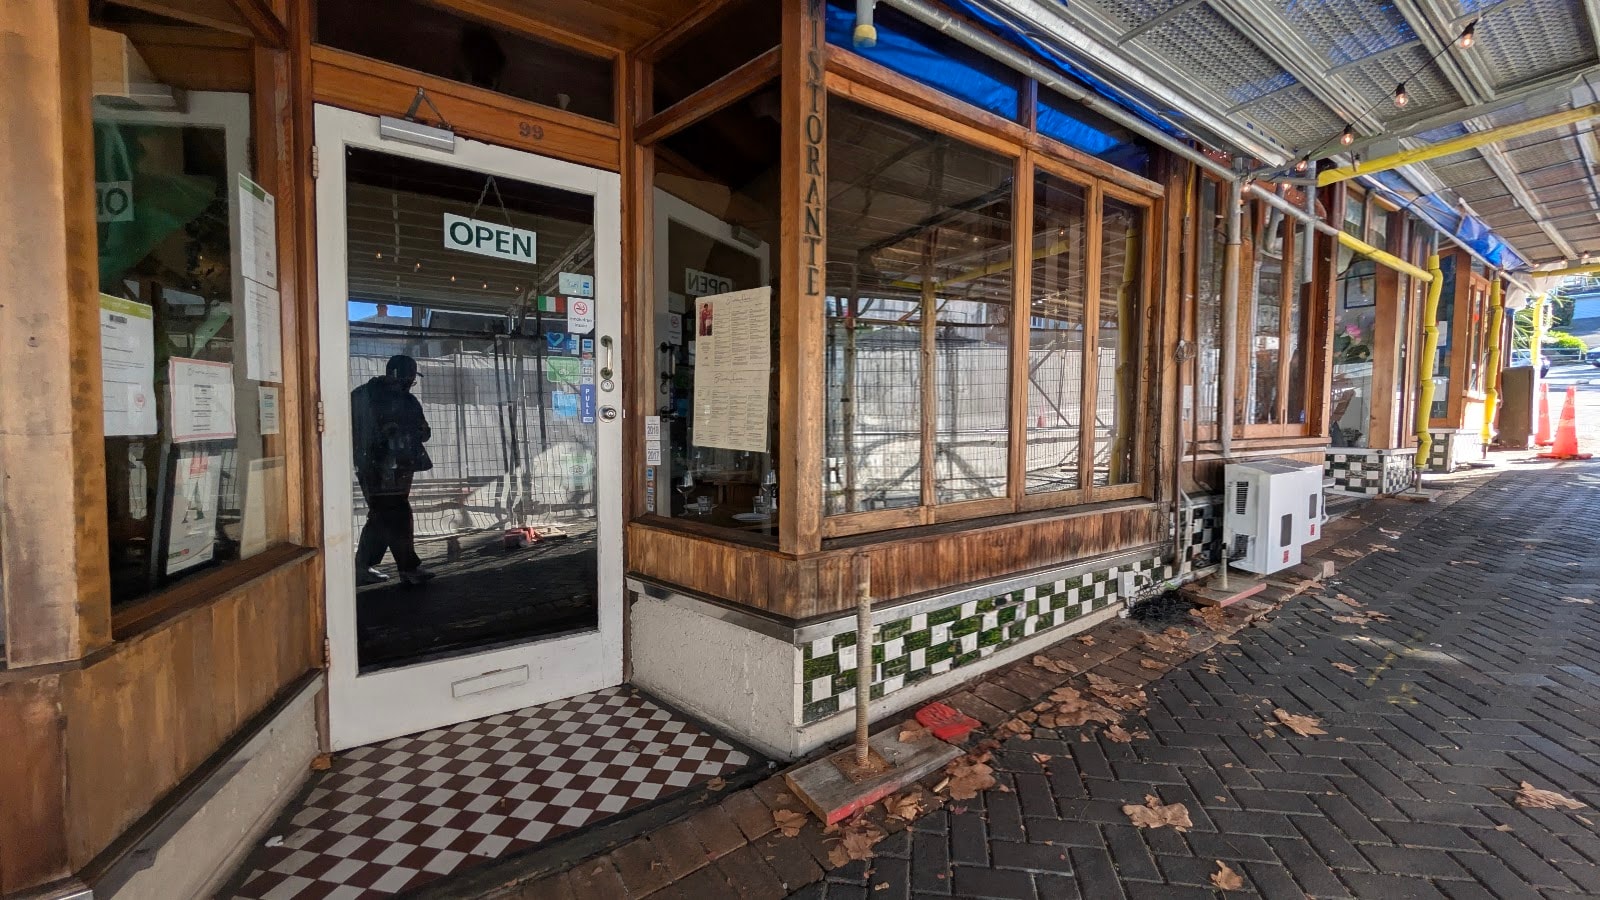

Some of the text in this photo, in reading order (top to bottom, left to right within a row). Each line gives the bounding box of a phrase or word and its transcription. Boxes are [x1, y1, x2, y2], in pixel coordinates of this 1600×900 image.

[519, 121, 544, 140] 99
[449, 221, 532, 258] OPEN
[647, 450, 660, 460] 2017
